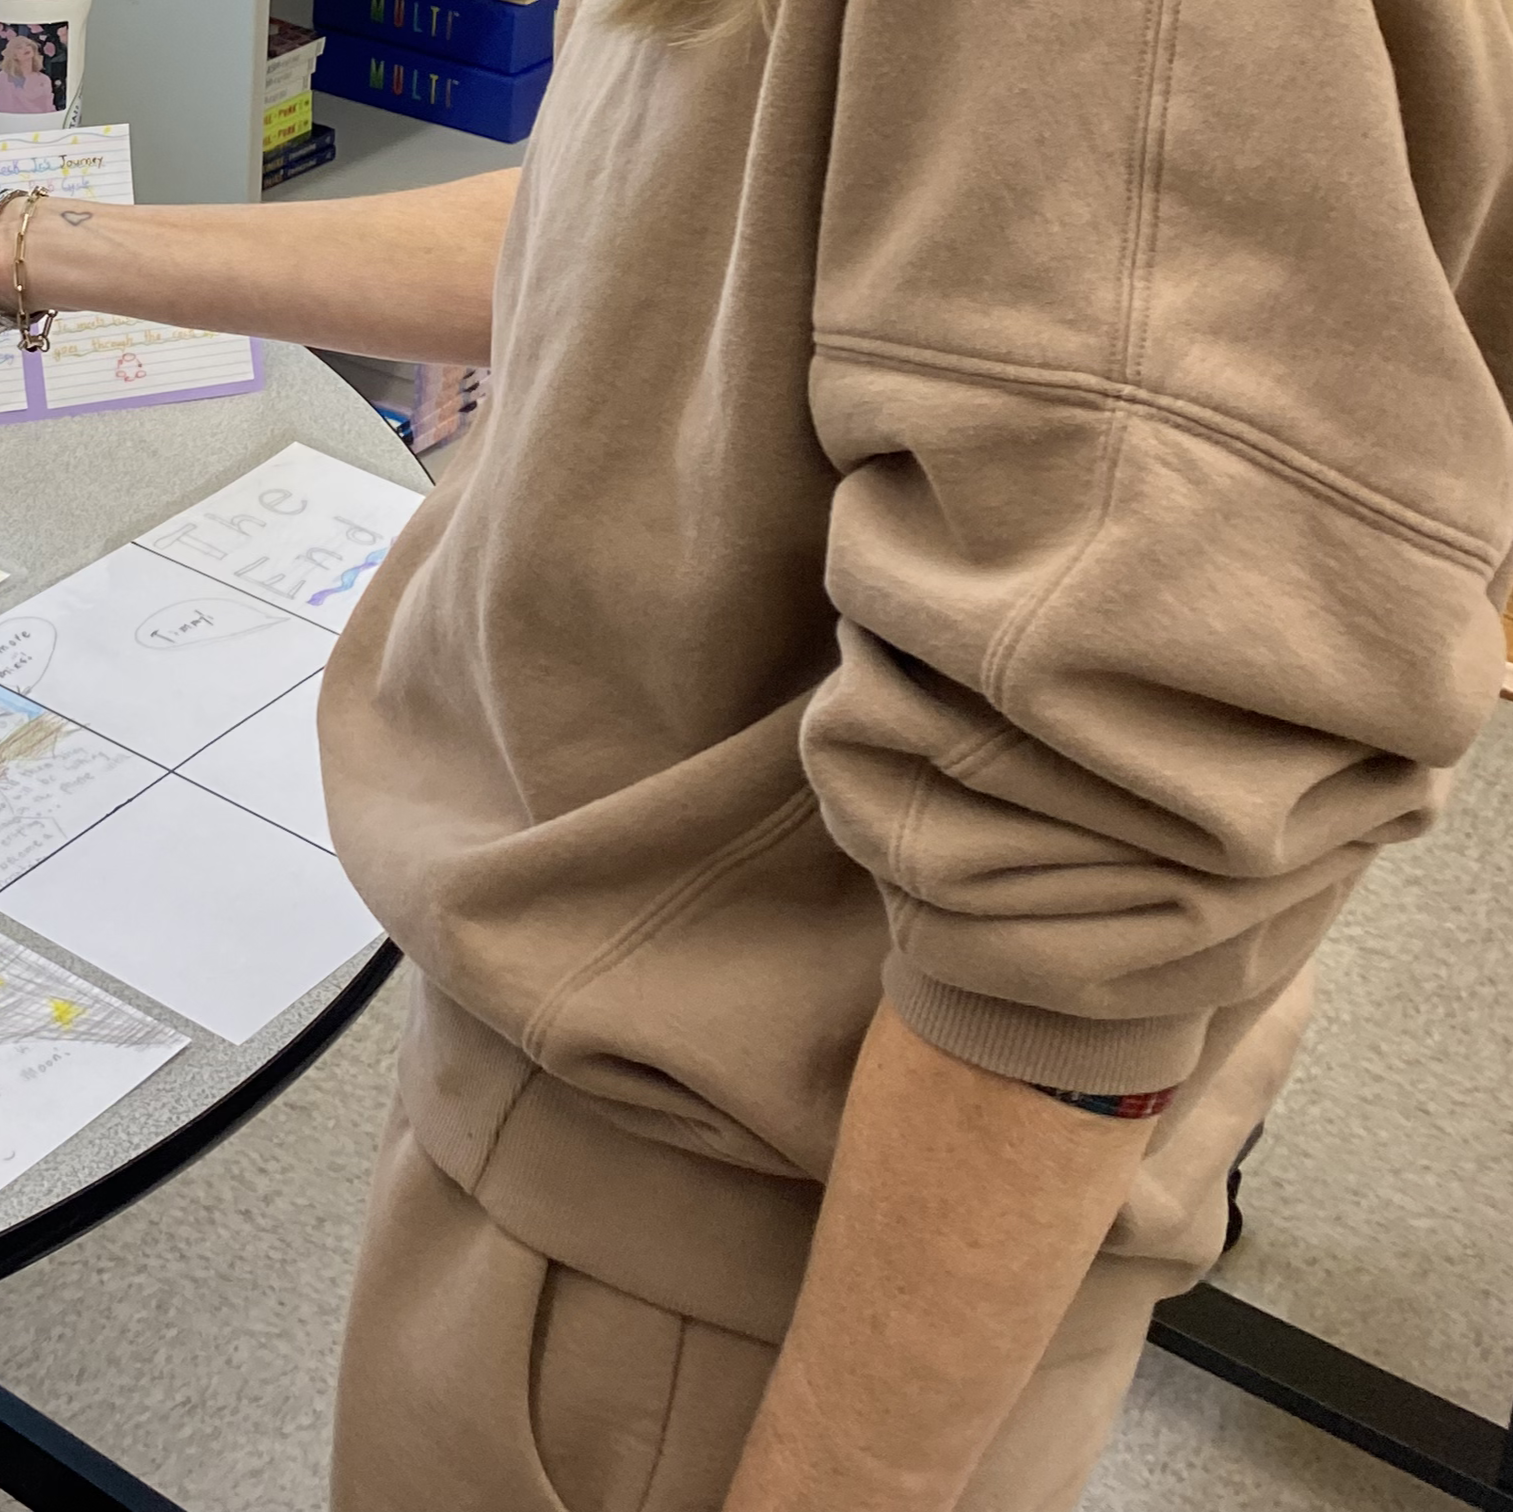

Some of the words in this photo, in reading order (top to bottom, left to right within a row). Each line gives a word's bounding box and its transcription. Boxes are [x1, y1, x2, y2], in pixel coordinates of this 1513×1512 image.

[369, 57, 452, 109] MULTI
[58, 154, 104, 170] Journey
[153, 488, 308, 560] The
[234, 516, 382, 603] End
